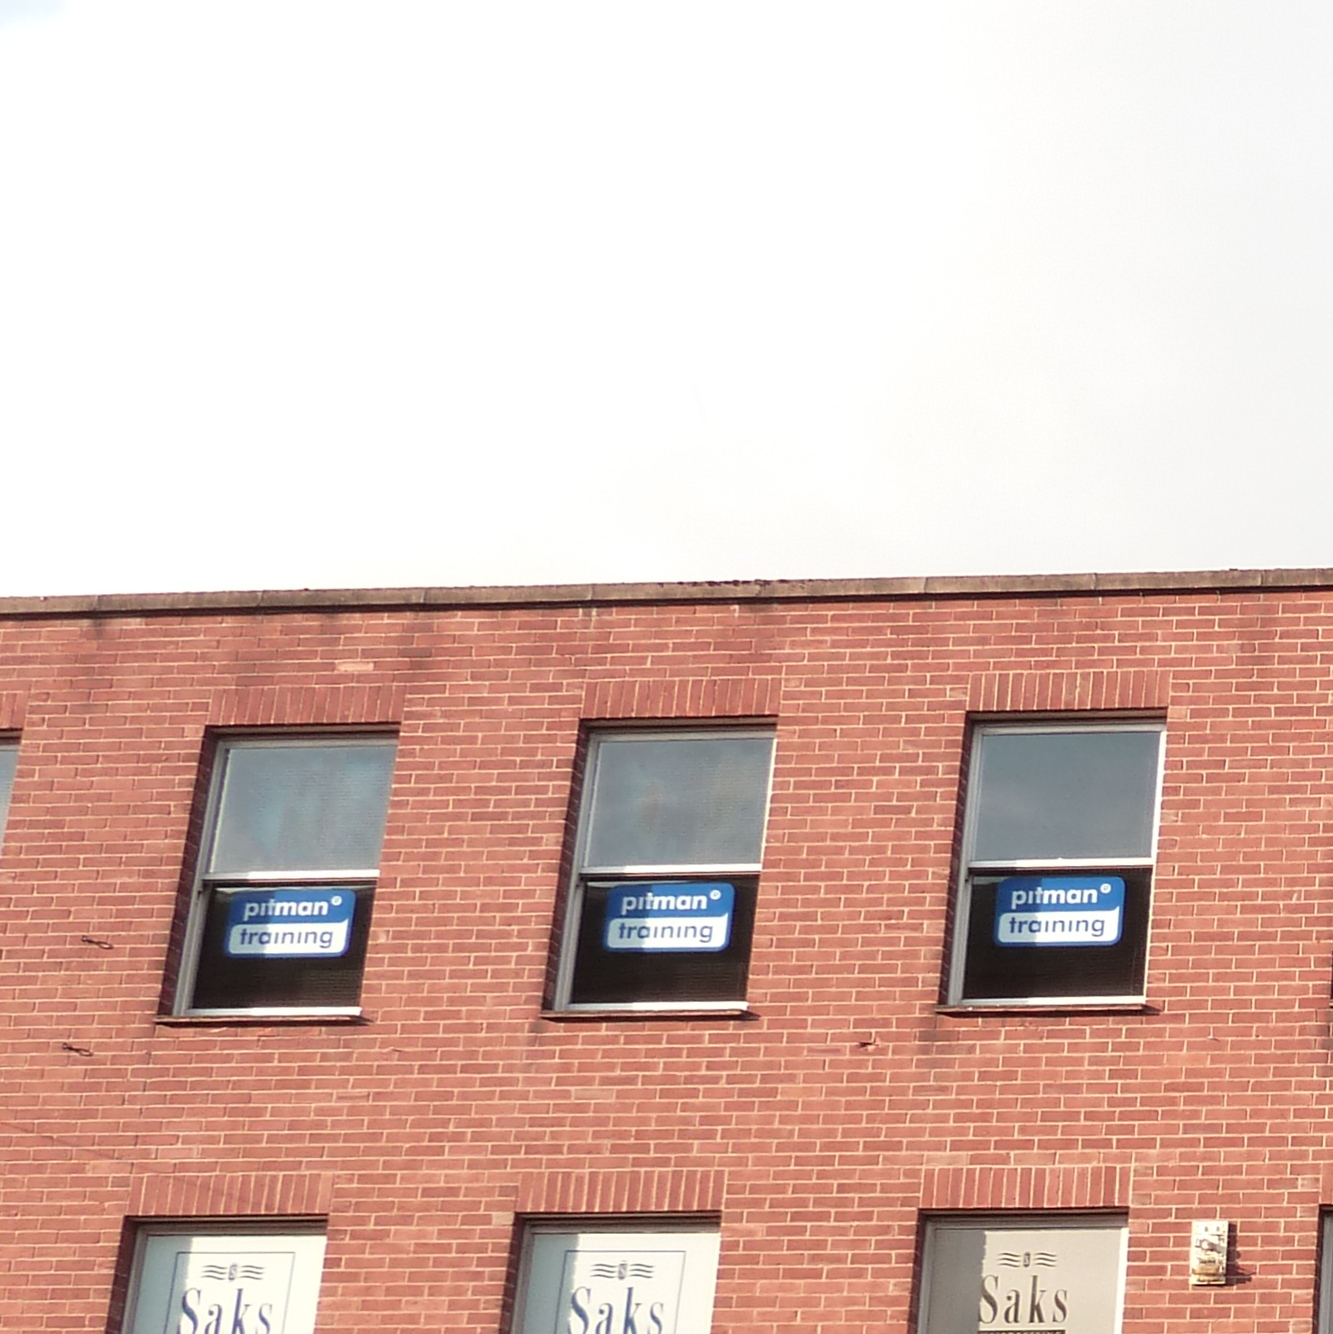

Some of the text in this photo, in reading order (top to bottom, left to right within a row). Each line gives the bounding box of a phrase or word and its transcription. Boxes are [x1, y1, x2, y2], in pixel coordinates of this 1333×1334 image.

[618, 922, 714, 943] training
[1008, 916, 1106, 938] training
[239, 928, 334, 949] training
[978, 1274, 1068, 1324] Saks
